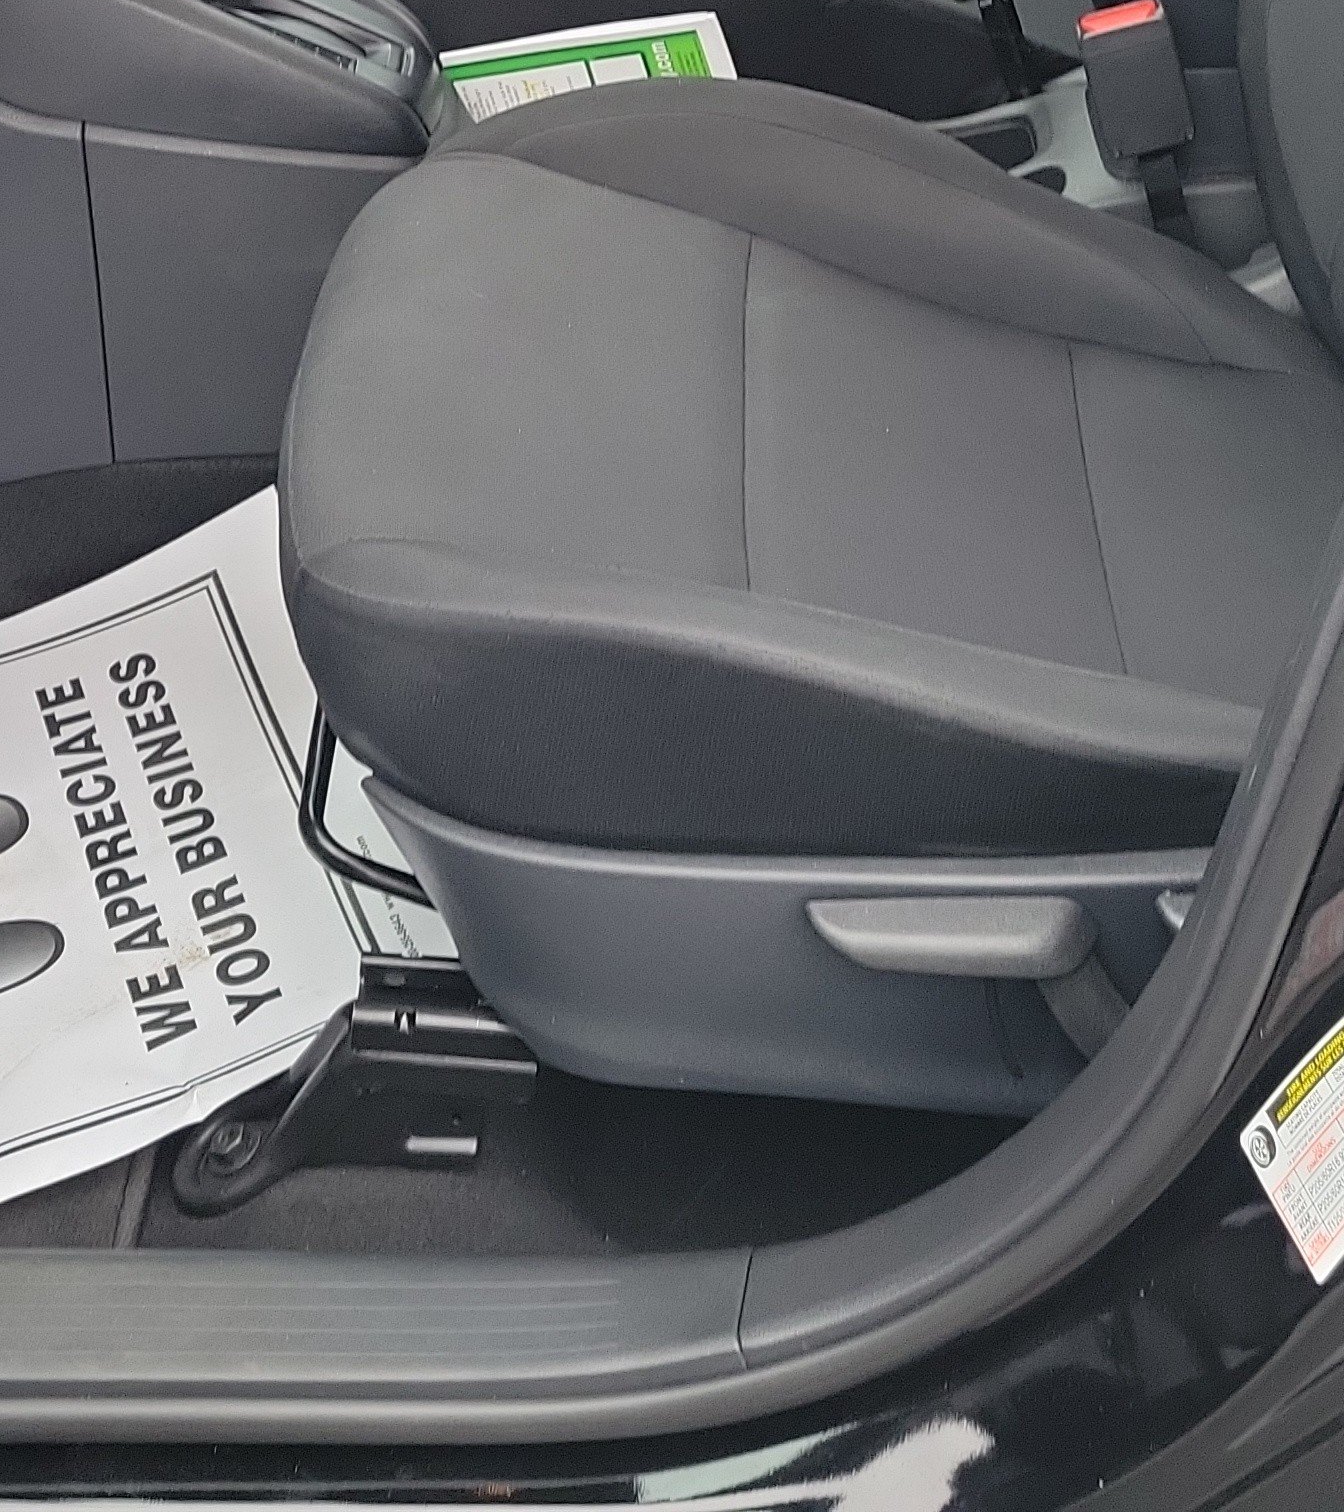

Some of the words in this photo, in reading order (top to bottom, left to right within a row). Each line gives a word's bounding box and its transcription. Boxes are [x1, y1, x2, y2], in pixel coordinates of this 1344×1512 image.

[34, 677, 170, 954] APPRECIATE
[108, 652, 228, 875] BUSINESS
[126, 963, 198, 1052] WE
[191, 874, 283, 1027] YOUR
[1298, 1060, 1316, 1082] AND
